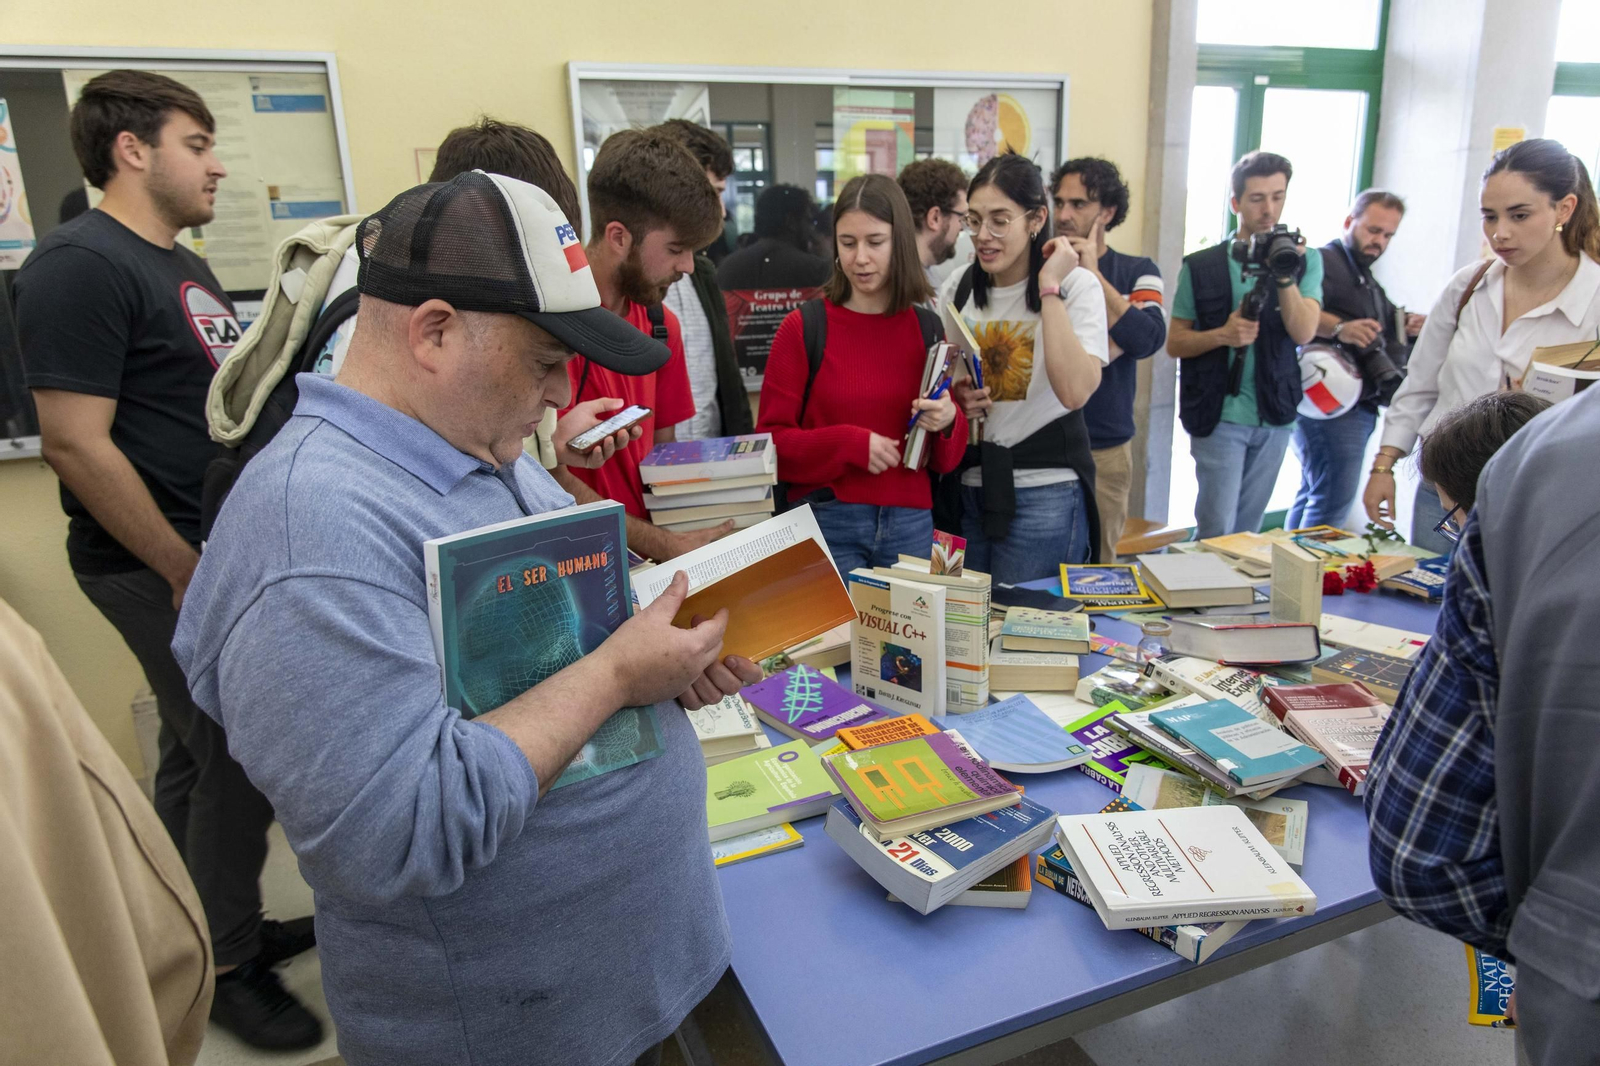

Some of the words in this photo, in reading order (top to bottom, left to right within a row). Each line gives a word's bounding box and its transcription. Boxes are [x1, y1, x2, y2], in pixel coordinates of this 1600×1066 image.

[754, 290, 787, 302] Grupo
[789, 289, 802, 299] de
[749, 302, 784, 312] Teatro
[497, 575, 514, 593] EL
[523, 565, 547, 586] SER
[557, 551, 608, 578] HUMANO
[871, 604, 898, 617] Progrese
[858, 611, 899, 636] VISUAL
[902, 624, 927, 641] C++
[1211, 669, 1251, 692] Internet
[850, 719, 906, 736] SEGUIMIENTO
[906, 717, 914, 725] Y
[1165, 714, 1191, 724] MAP
[854, 725, 909, 741] EVALUACION
[861, 732, 911, 746] PROYECTOS
[1083, 724, 1110, 740] LA
[1080, 764, 1107, 786] CABRA
[1108, 779, 1119, 792] LA
[912, 832, 938, 846] ver
[934, 827, 974, 852] 2000
[1105, 821, 1134, 853] ANALYSIS
[887, 841, 920, 863] 21
[1108, 844, 1133, 872] APPLIED
[1128, 837, 1150, 861] OTHER
[1135, 829, 1180, 883] MULTIVARIABLE
[1153, 837, 1185, 873] METHODS
[1039, 864, 1045, 874] LA
[1045, 867, 1058, 882] BIBLIA
[1058, 874, 1065, 885] DE
[1125, 852, 1163, 897] REGRESSION
[1144, 860, 1164, 877] AND
[1199, 909, 1239, 918] REGRESSION
[1239, 907, 1270, 915] ANALYSIS
[1481, 953, 1499, 993] NATI
